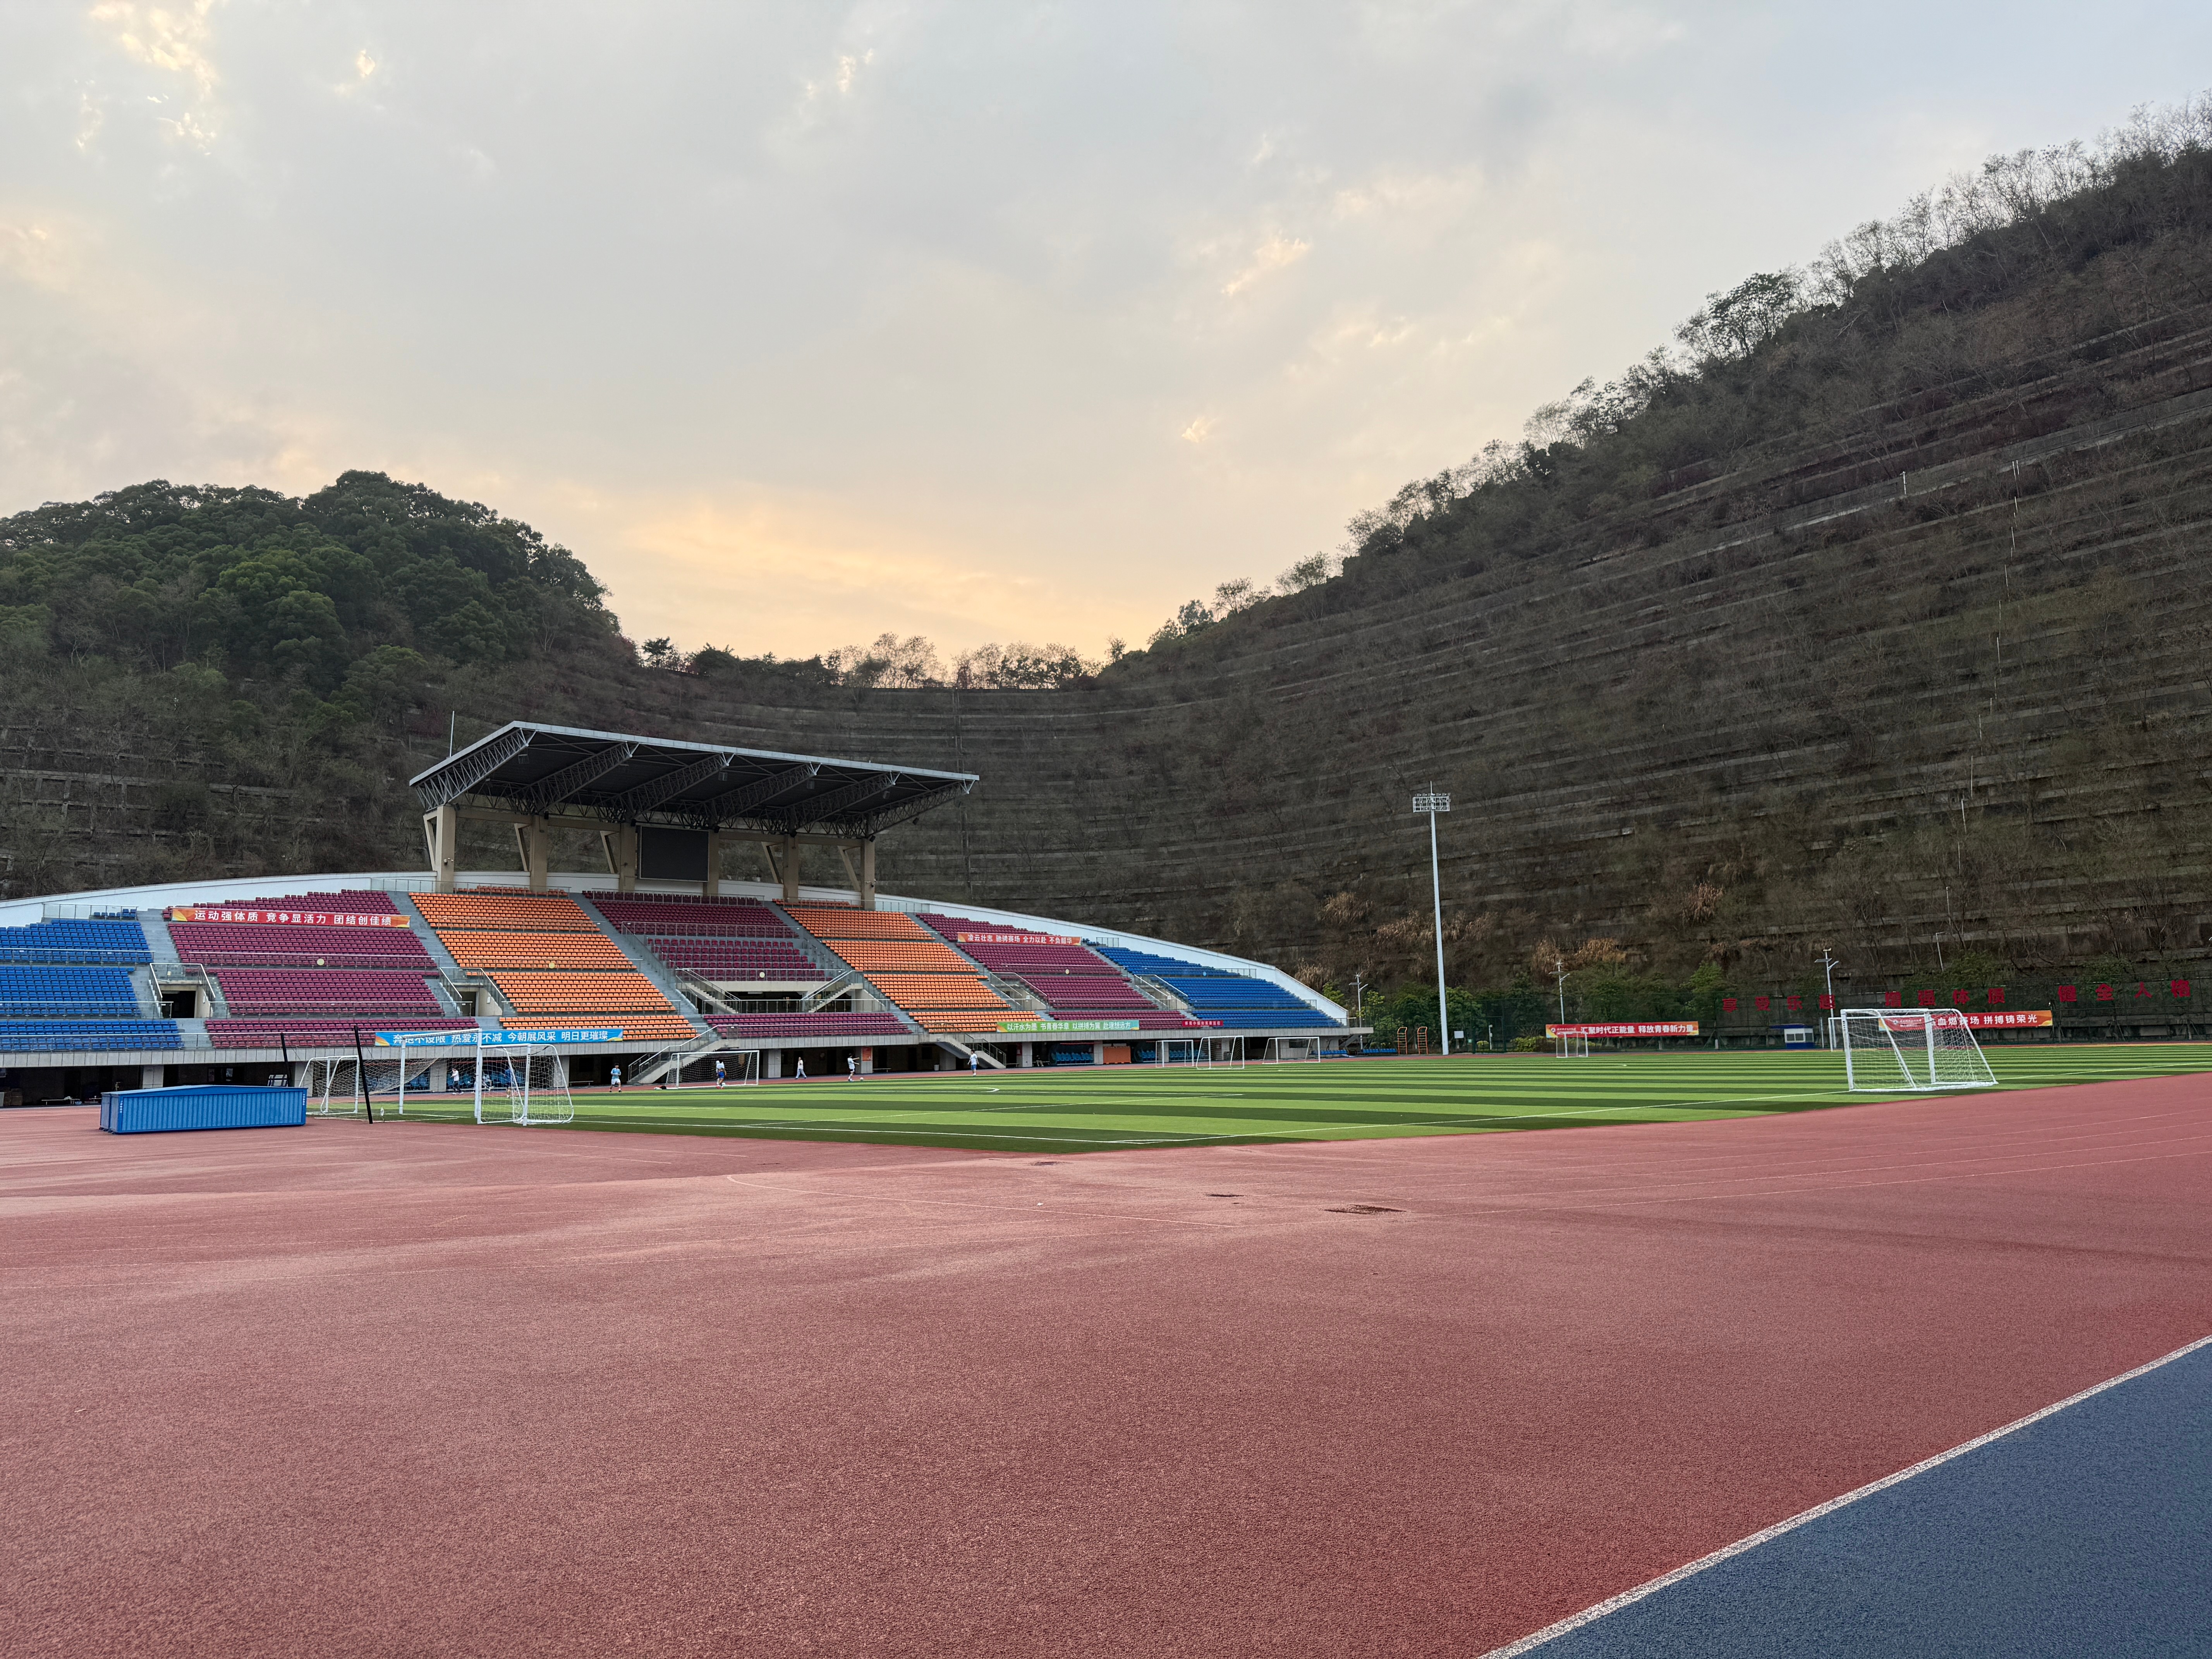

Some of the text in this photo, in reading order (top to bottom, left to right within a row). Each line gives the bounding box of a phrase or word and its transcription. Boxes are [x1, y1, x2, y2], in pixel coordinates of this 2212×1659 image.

[194, 910, 392, 926] 运动强体质 竞争显活力 团结创佳绩
[1885, 987, 2005, 1007] 增强体质
[2057, 979, 2191, 1002] 健全人格
[1984, 1014, 2037, 1024] 拼搏铸荣光
[1581, 1025, 1635, 1034] 汇聚时代正能量
[1638, 1024, 1693, 1034] 释放青春新力量
[508, 1031, 556, 1042] 今朝展风采
[562, 1030, 608, 1041] 明日更璀璨
